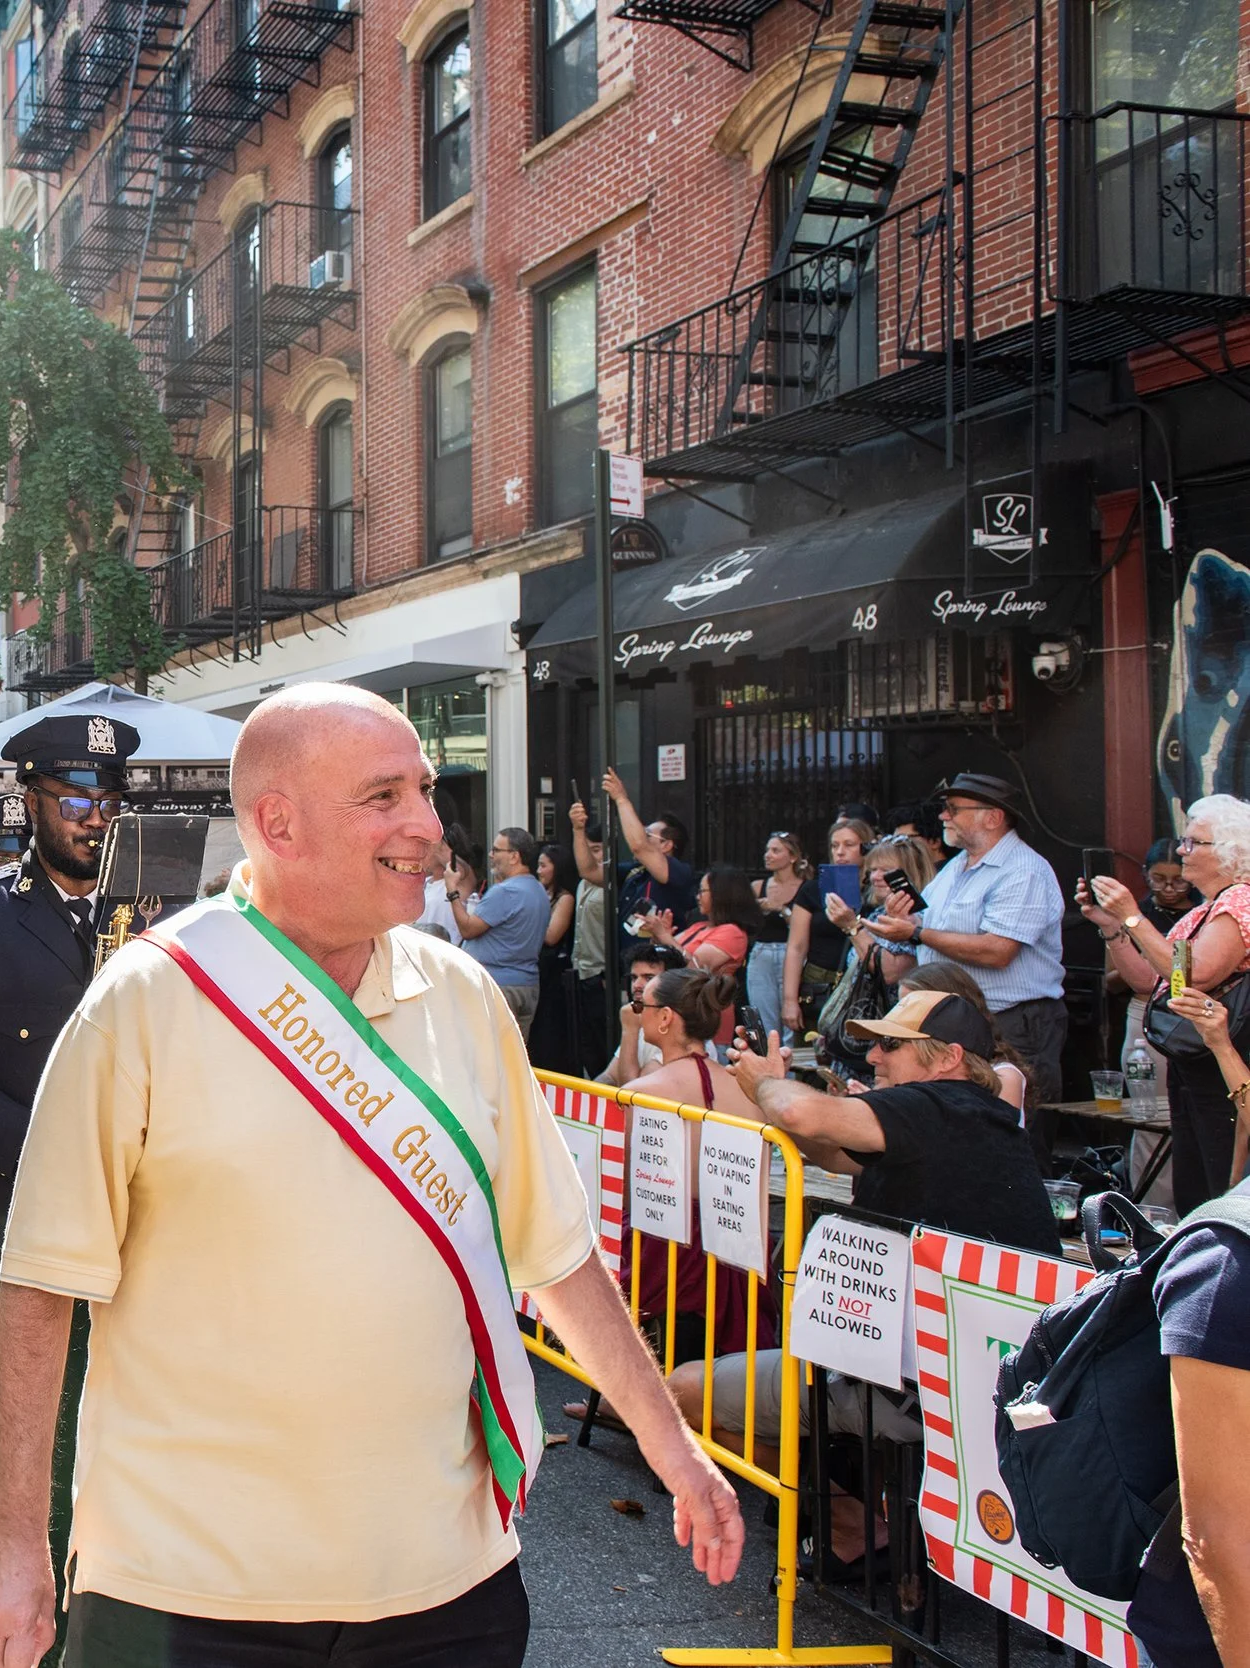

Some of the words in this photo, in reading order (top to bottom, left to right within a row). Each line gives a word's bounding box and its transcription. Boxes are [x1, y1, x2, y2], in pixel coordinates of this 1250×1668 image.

[612, 550, 657, 561] GUINNESS
[931, 589, 988, 624] Spring
[990, 590, 1048, 620] Lounge
[852, 604, 878, 631] 48
[613, 633, 677, 668] Spring
[679, 622, 754, 653] Lounge
[532, 660, 551, 681] 48
[152, 803, 206, 812] Subway
[257, 982, 396, 1129] Honored
[392, 1124, 468, 1227] Guest
[641, 1134, 664, 1148] AREAS
[639, 1151, 651, 1163] ARE
[652, 1154, 668, 1167] FOR
[704, 1146, 716, 1158] NO
[717, 1149, 756, 1169] SMOKING
[635, 1168, 652, 1182] Spring
[654, 1172, 676, 1189] Lounge
[707, 1163, 718, 1175] OR
[720, 1168, 751, 1185] VAPING
[635, 1187, 677, 1207] CUSTOMERS
[723, 1184, 733, 1197] IN
[645, 1208, 664, 1222] ONLY
[712, 1197, 745, 1217] SEATING
[717, 1216, 742, 1233] AREAS
[822, 1226, 888, 1256] WALKING
[818, 1248, 884, 1276] AROUND
[804, 1263, 836, 1285] WITH
[841, 1275, 897, 1302] DRINKS
[822, 1290, 834, 1305] IS
[838, 1296, 872, 1317] NOT
[809, 1308, 882, 1341] ALLOWED
